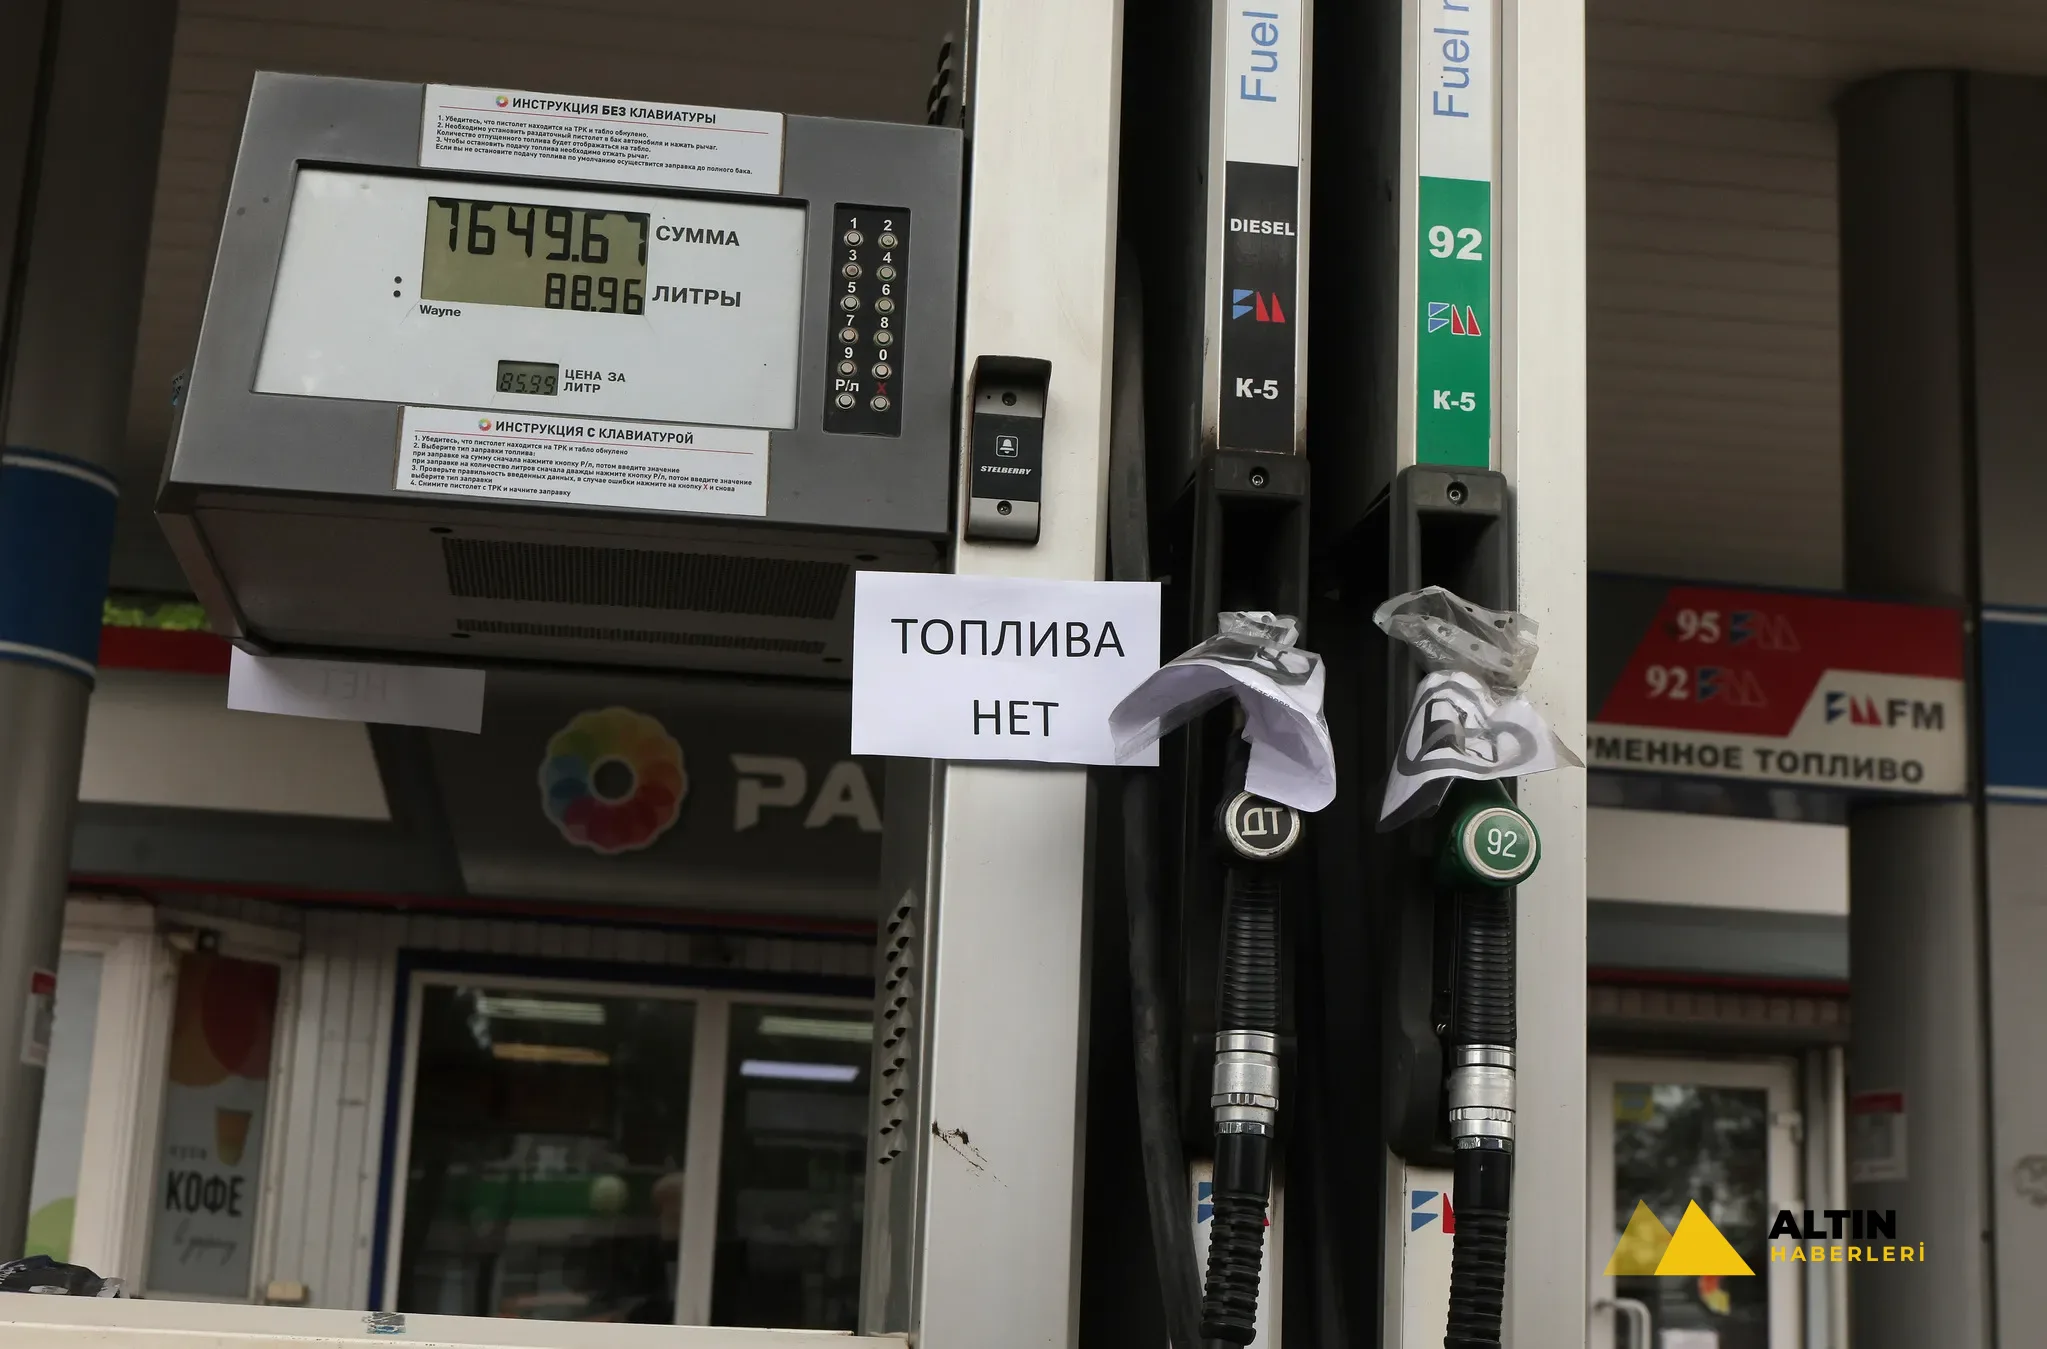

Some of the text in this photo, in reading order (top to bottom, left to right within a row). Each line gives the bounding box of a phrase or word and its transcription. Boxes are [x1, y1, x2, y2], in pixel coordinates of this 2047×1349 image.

[1240, 11, 1279, 102] Fuel
[1433, 28, 1469, 118] Fuel
[512, 98, 715, 123] ИНСТРУКЦИЯ БЕЗ КЛАВИАТУРЫ
[436, 200, 647, 266] 7649.67
[655, 225, 740, 247] СУММА
[850, 217, 893, 231] 1 2
[1230, 218, 1295, 236] DIESEL
[1428, 225, 1483, 261] 92
[849, 249, 892, 263] 3 4
[545, 273, 644, 315] 88.96
[652, 285, 741, 308] ЛИТРЫ
[847, 281, 890, 296] 5 6
[419, 304, 461, 317] Wayne
[846, 314, 889, 328] 7 8
[844, 347, 888, 361] 9 0
[500, 373, 556, 395] 85.99
[563, 382, 601, 393] ЛИТР
[565, 369, 626, 382] ЦЕНА ЗА
[495, 421, 693, 443] ИНСТРУКЦИЯ С КЛАВИАТУРОЙ
[980, 465, 1031, 475] STELBERRY
[891, 617, 1126, 659] ТОПЛИВА
[1676, 609, 1721, 643] 95
[1646, 665, 1690, 699] 92
[972, 699, 1059, 738] НЕТ
[1887, 698, 1946, 731] FM
[1754, 748, 1925, 784] ТОПЛИВО
[1241, 807, 1284, 836] ДТ
[1487, 830, 1518, 858] 92
[166, 1168, 245, 1218] КОФЕ
